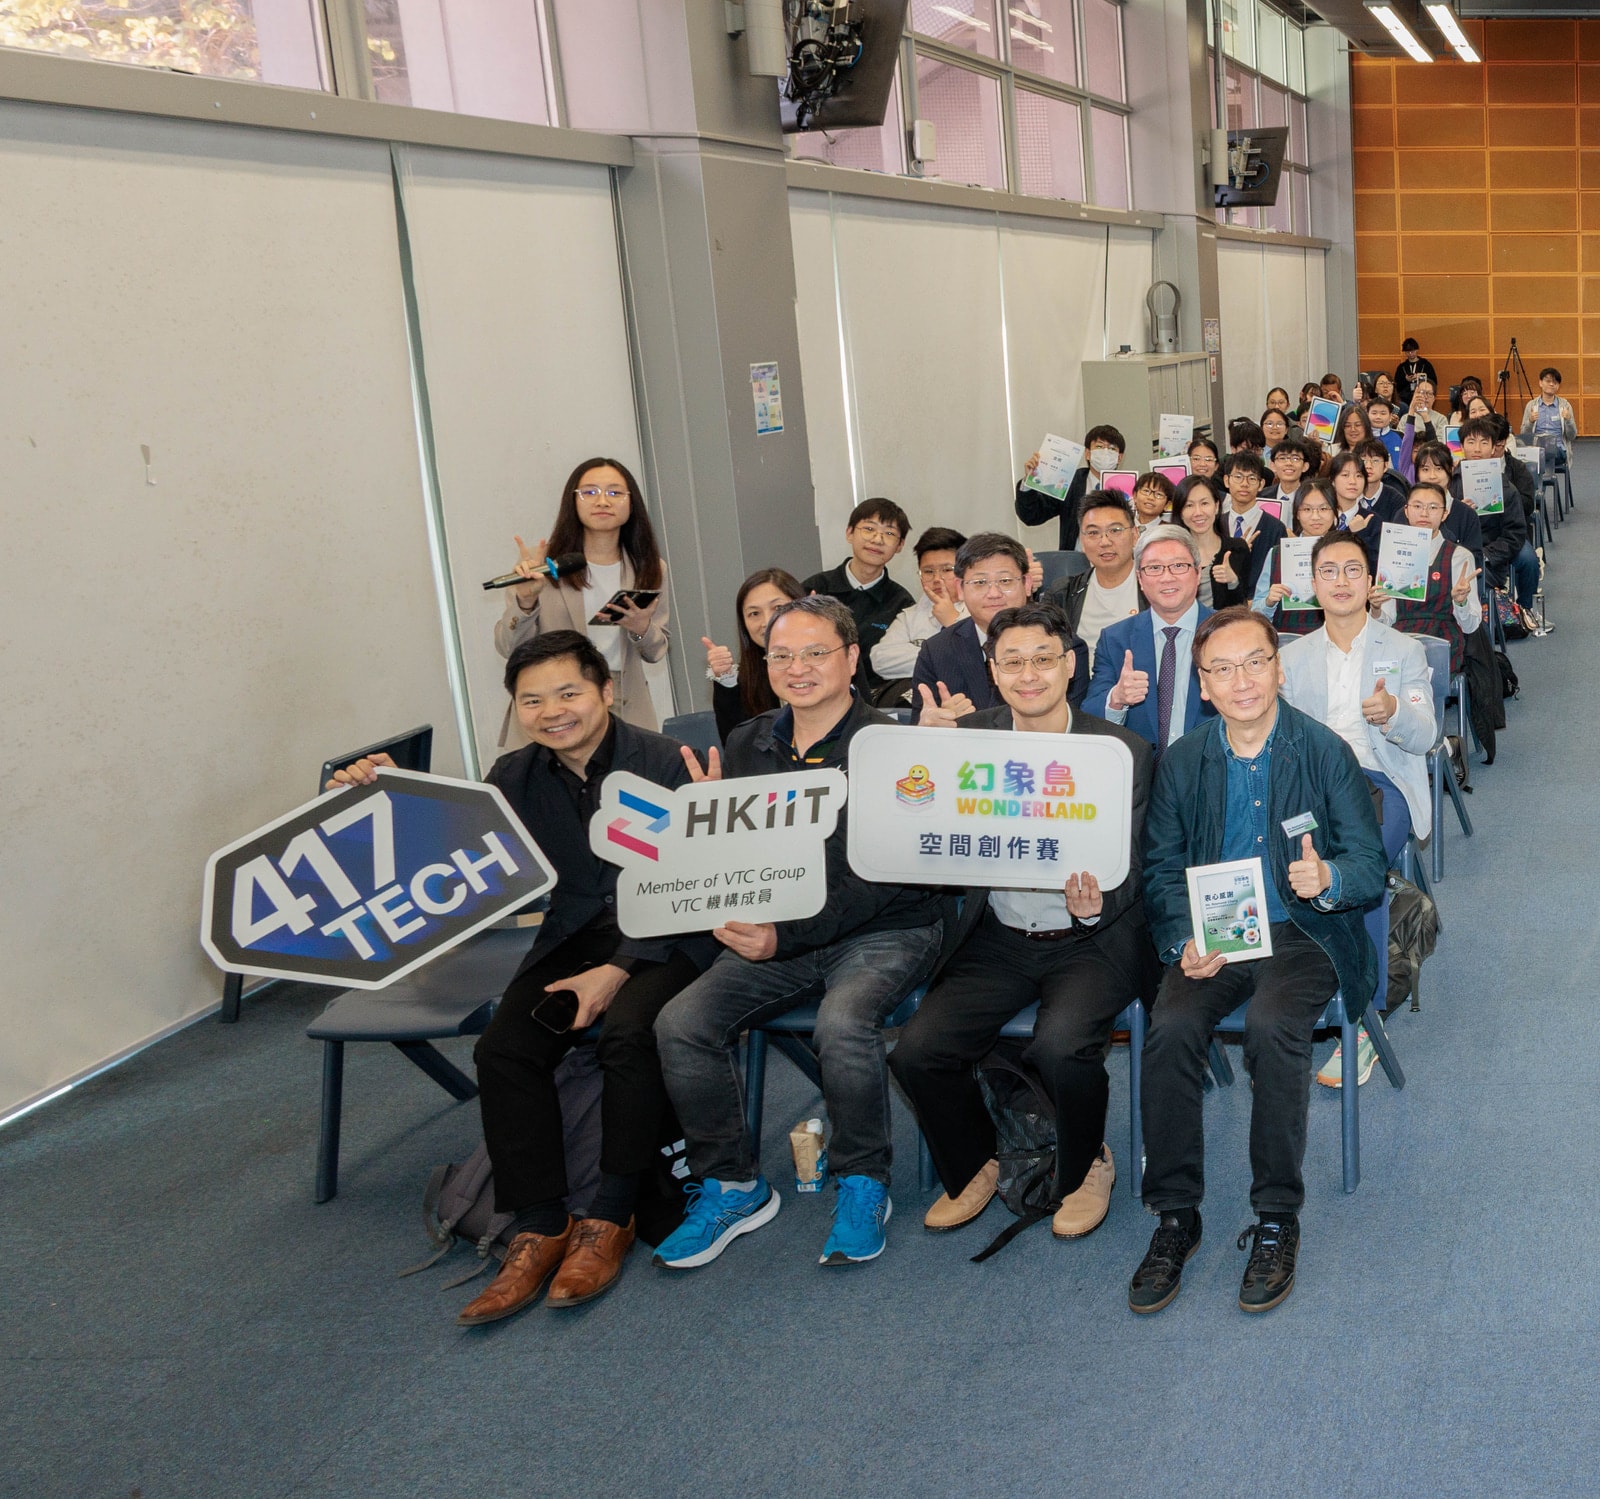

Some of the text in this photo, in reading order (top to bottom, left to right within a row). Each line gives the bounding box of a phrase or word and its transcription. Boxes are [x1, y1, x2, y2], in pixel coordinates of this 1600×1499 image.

[957, 760, 1076, 797] 幻象島
[956, 797, 1097, 820] WONDERLAND
[919, 833, 1060, 861] 空間創作賽
[232, 790, 395, 948] 417
[636, 866, 806, 896] Member of VTC Group
[320, 831, 519, 960] TECH
[671, 888, 772, 914] VTC 機構成員
